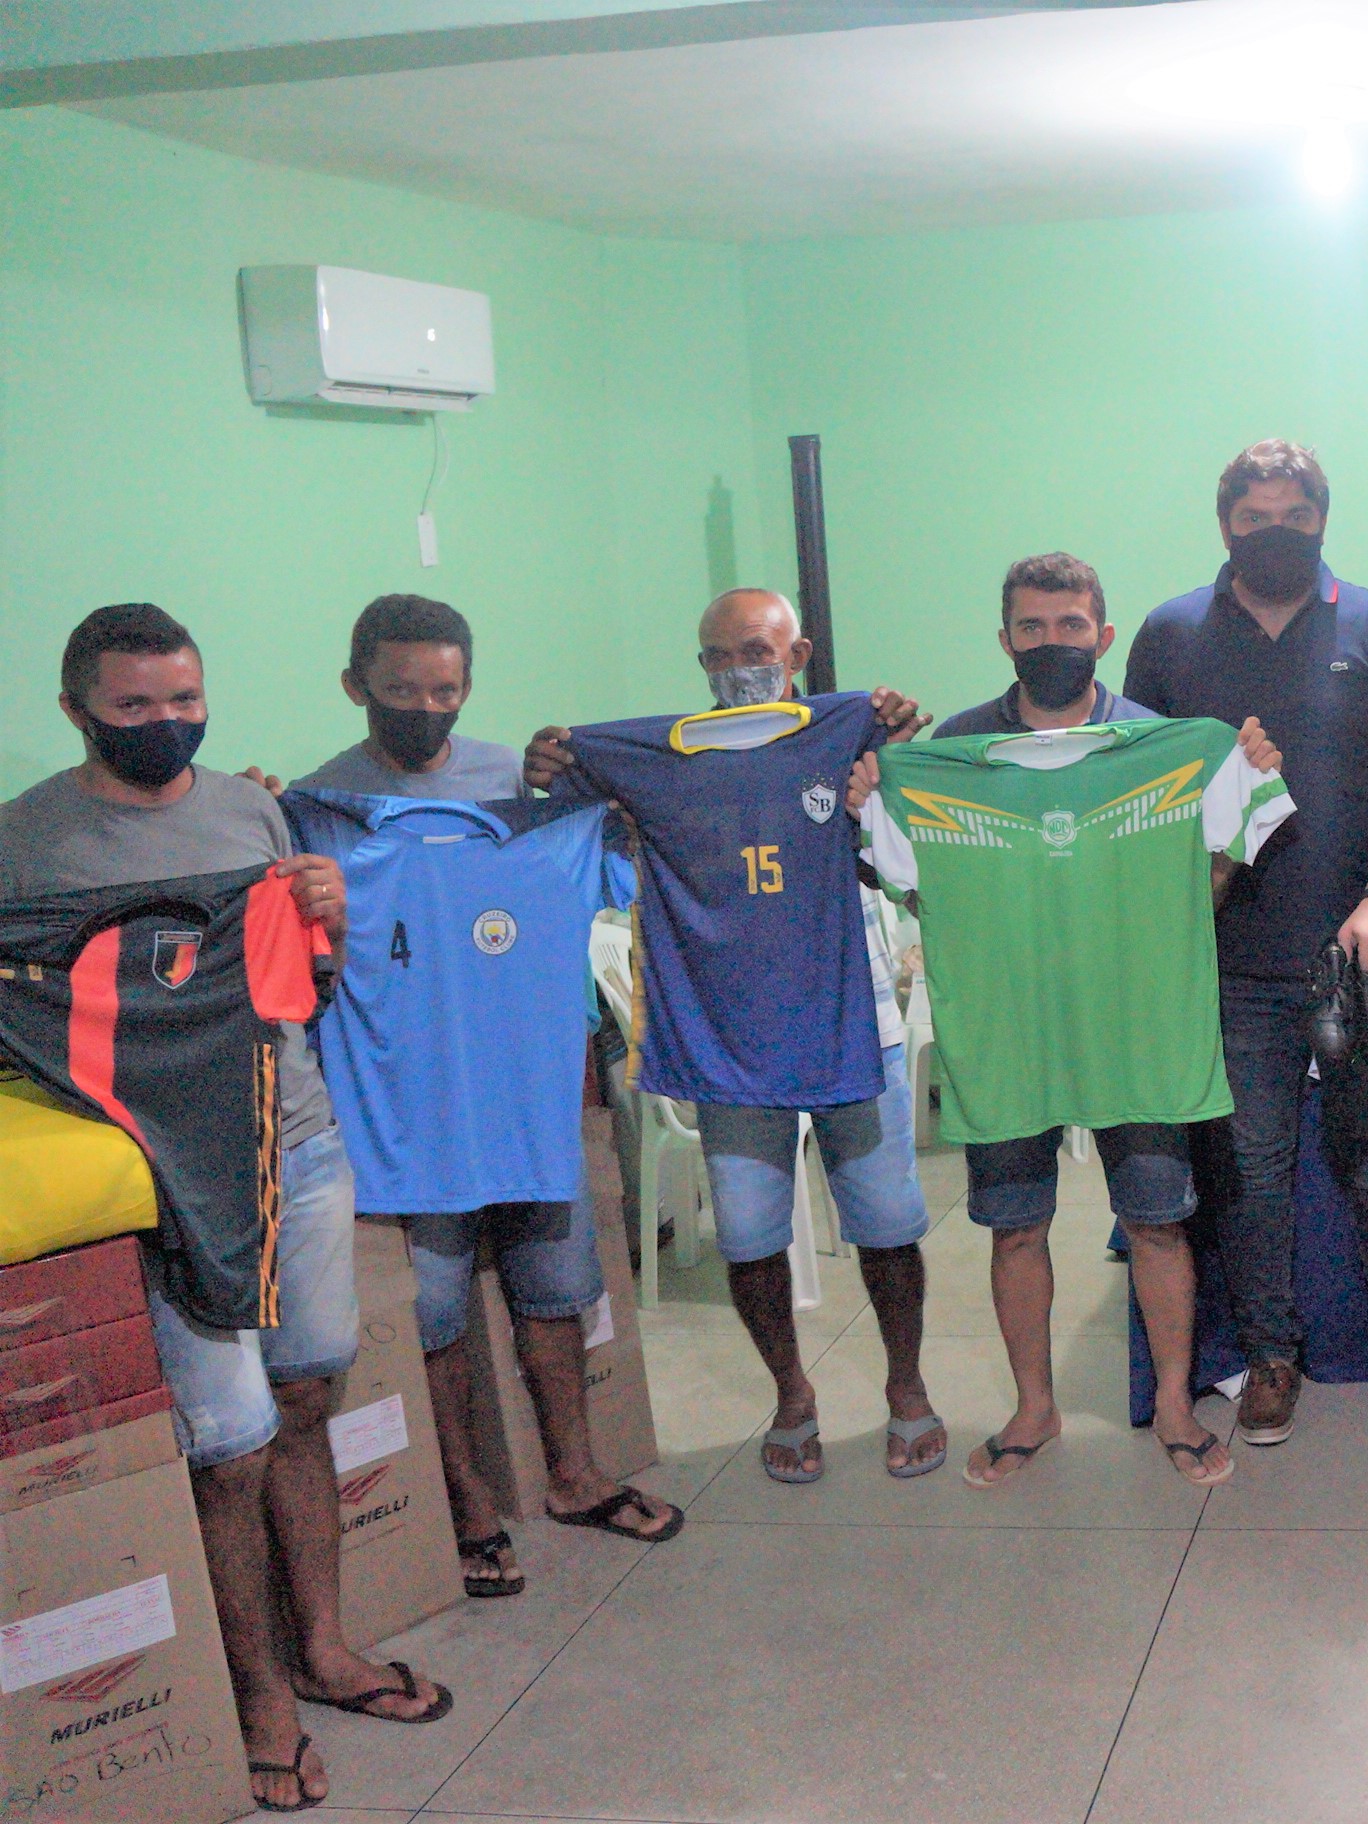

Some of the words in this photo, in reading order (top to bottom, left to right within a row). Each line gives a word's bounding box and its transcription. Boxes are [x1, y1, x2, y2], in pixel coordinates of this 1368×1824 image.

[740, 844, 784, 895] 15
[390, 919, 412, 968] 4
[340, 1496, 410, 1535] URIELLI
[50, 1687, 172, 1744] MURIELLI
